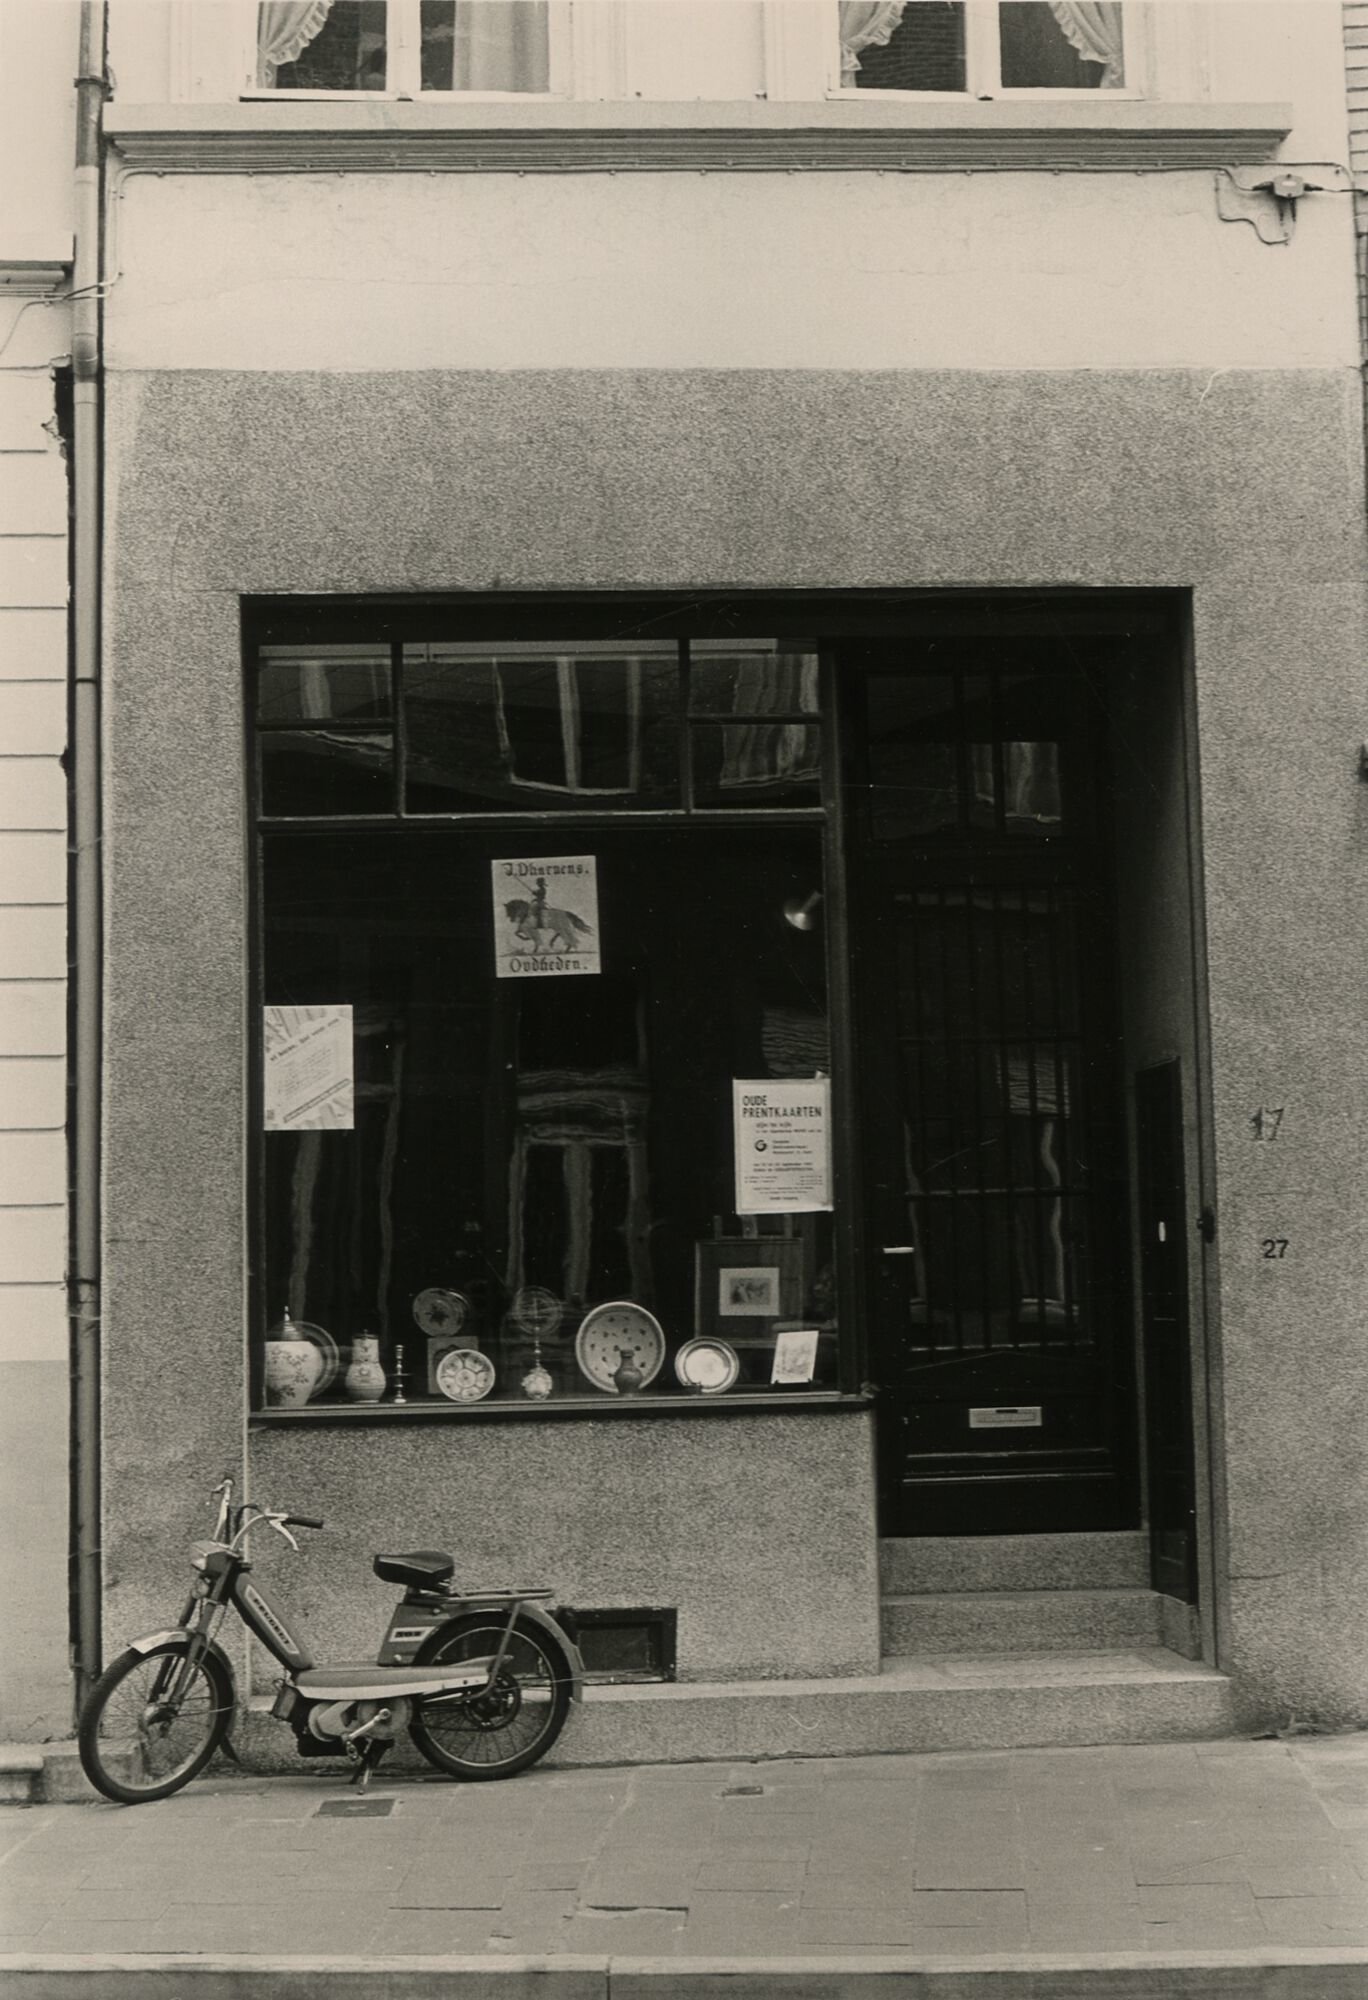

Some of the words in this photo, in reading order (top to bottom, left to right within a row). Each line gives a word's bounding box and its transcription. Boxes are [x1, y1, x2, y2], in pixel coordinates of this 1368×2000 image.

[742, 1095, 767, 1106] OUDE
[742, 1107, 822, 1118] PRENTKAARTEN
[1249, 1107, 1285, 1140] 17
[1262, 1239, 1289, 1259] 27
[253, 1598, 290, 1645] PEUGEOT
